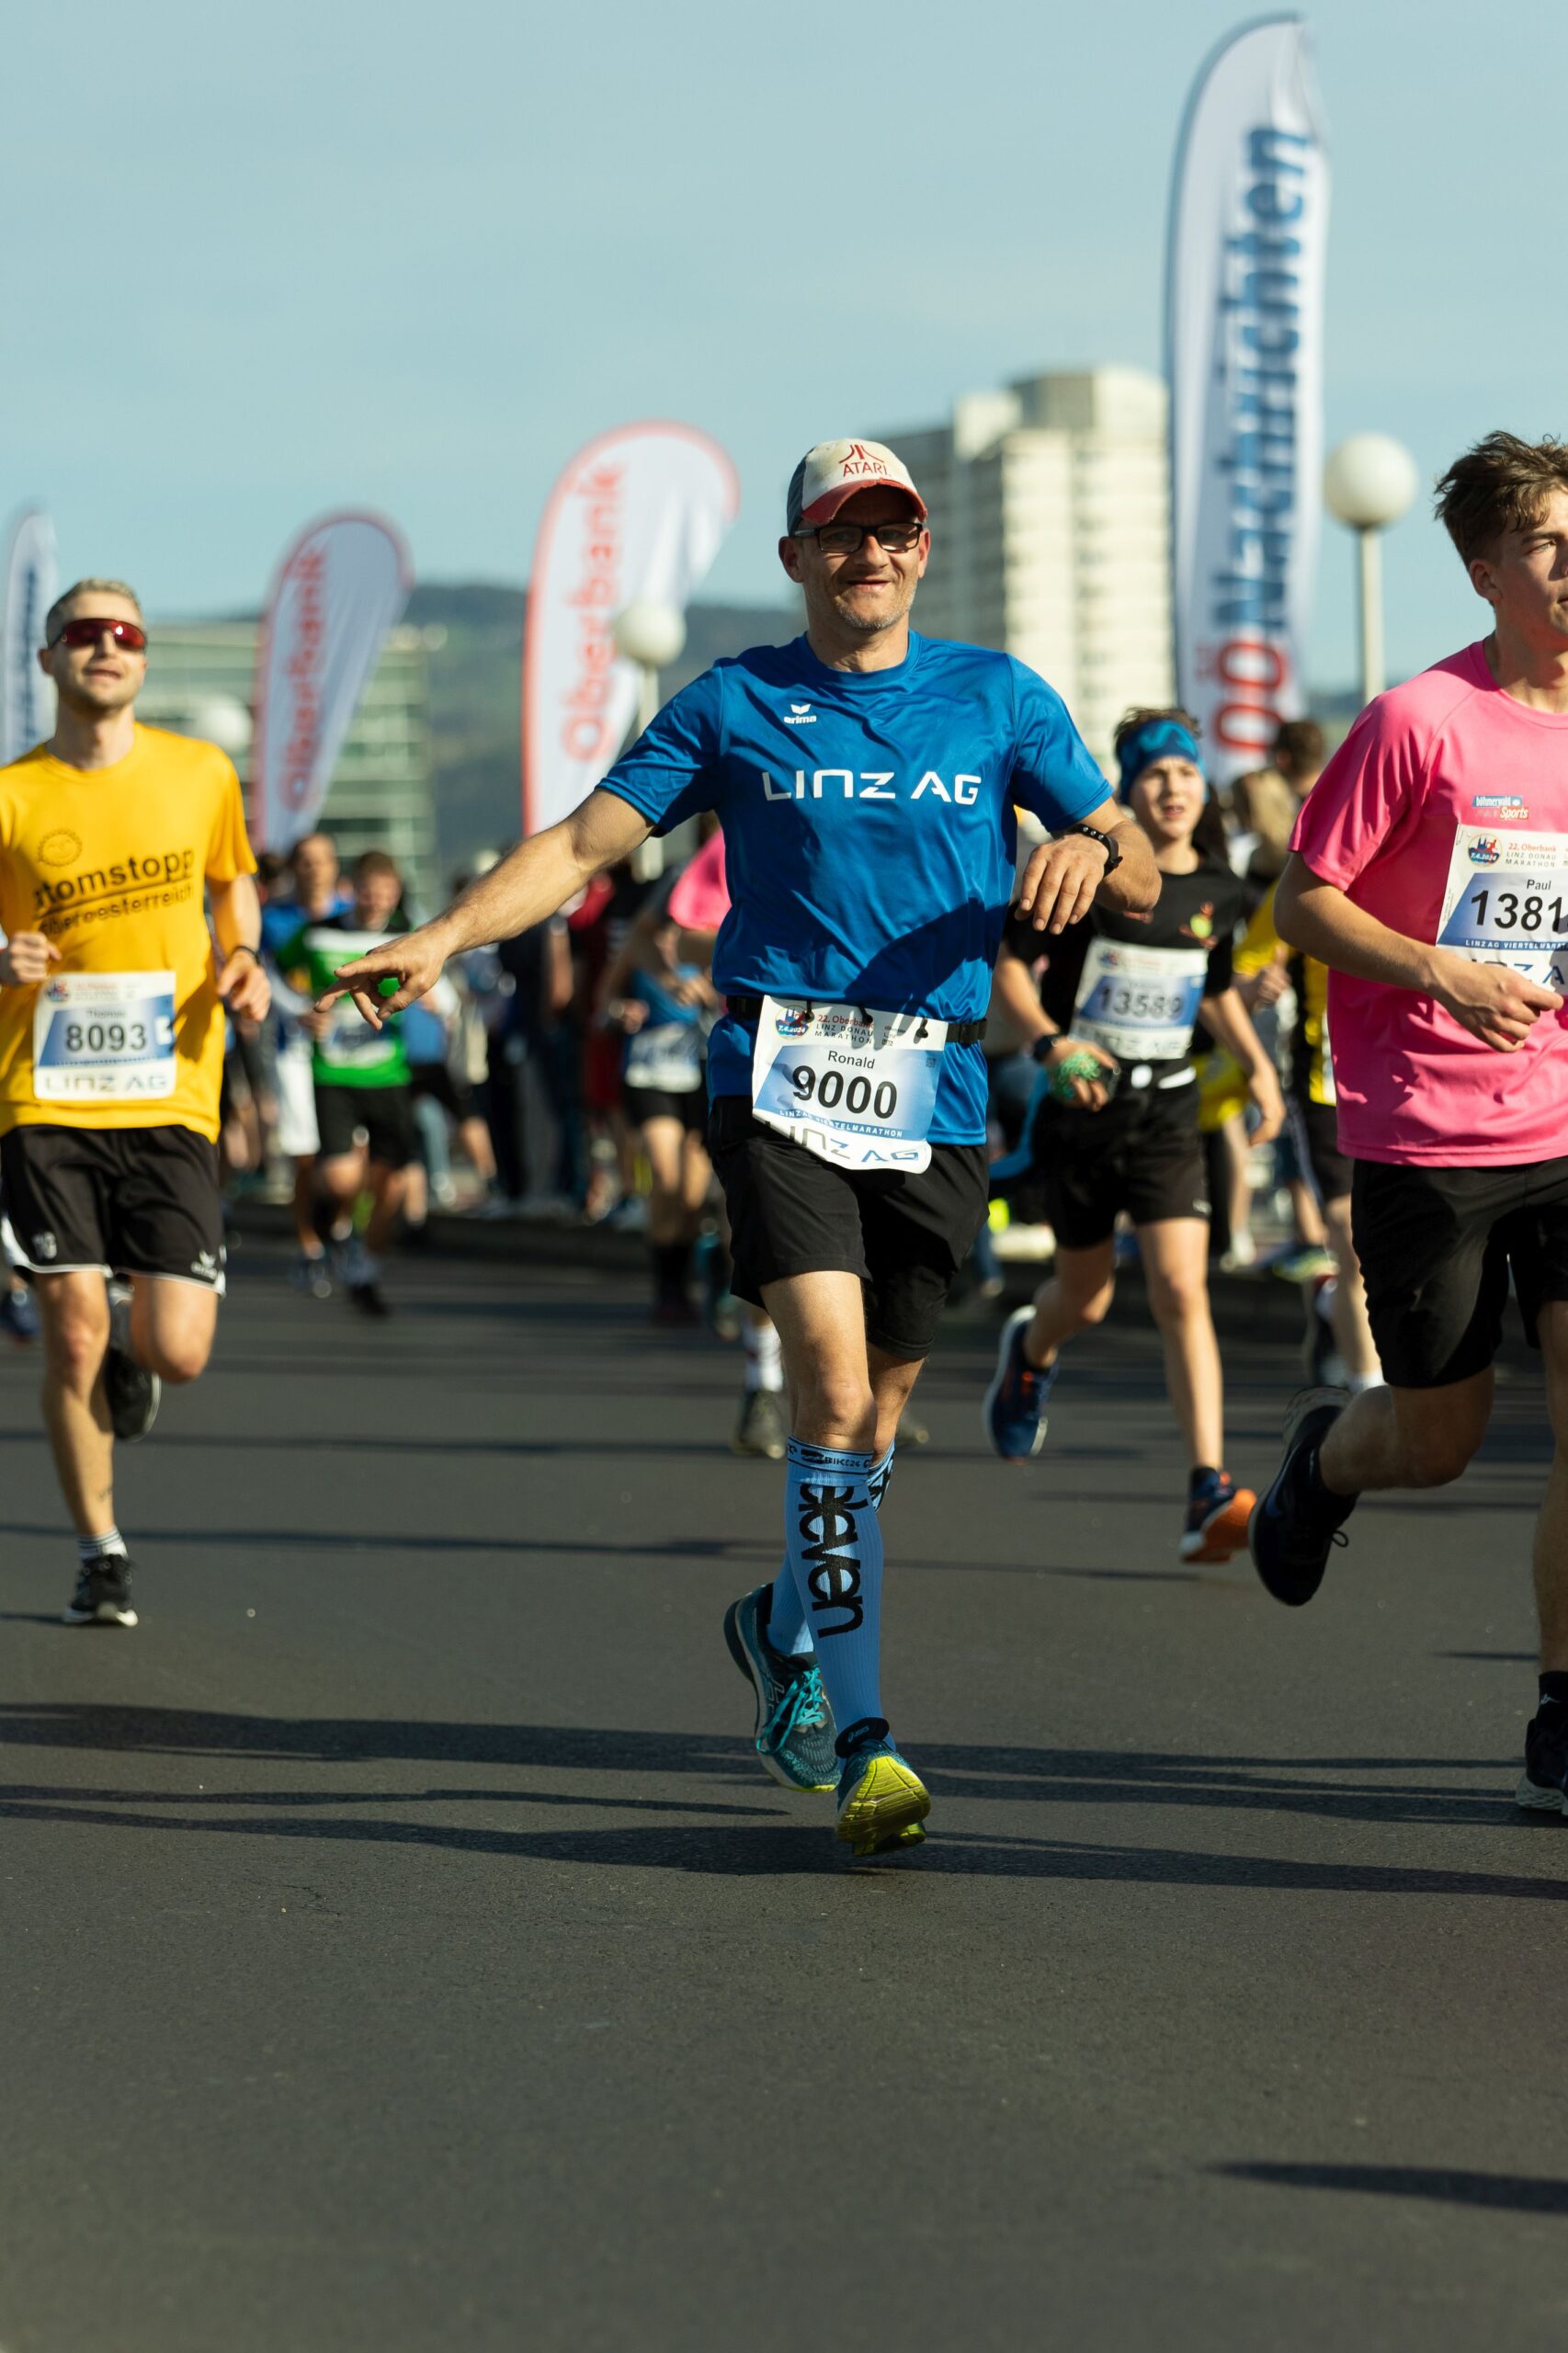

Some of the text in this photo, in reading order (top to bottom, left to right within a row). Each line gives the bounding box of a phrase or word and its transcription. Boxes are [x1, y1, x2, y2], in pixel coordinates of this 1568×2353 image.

[843, 461, 888, 477] ATARI
[783, 715, 817, 724] erima
[910, 771, 982, 805] AG
[1500, 807, 1528, 820] Sports
[1505, 858, 1555, 867] MARATHON
[1527, 879, 1551, 890] Paul
[1471, 890, 1568, 932] 1381
[1099, 985, 1184, 1020] 13589
[818, 1015, 830, 1023] 22.
[66, 1022, 146, 1052] 8093
[814, 1030, 872, 1044] MARATHON
[815, 1023, 836, 1031] LINZ
[840, 1025, 874, 1037] DONAU
[828, 1050, 876, 1069] Ronald
[126, 1073, 166, 1092] AG
[792, 1065, 898, 1120] 9000
[860, 1148, 920, 1164] AG
